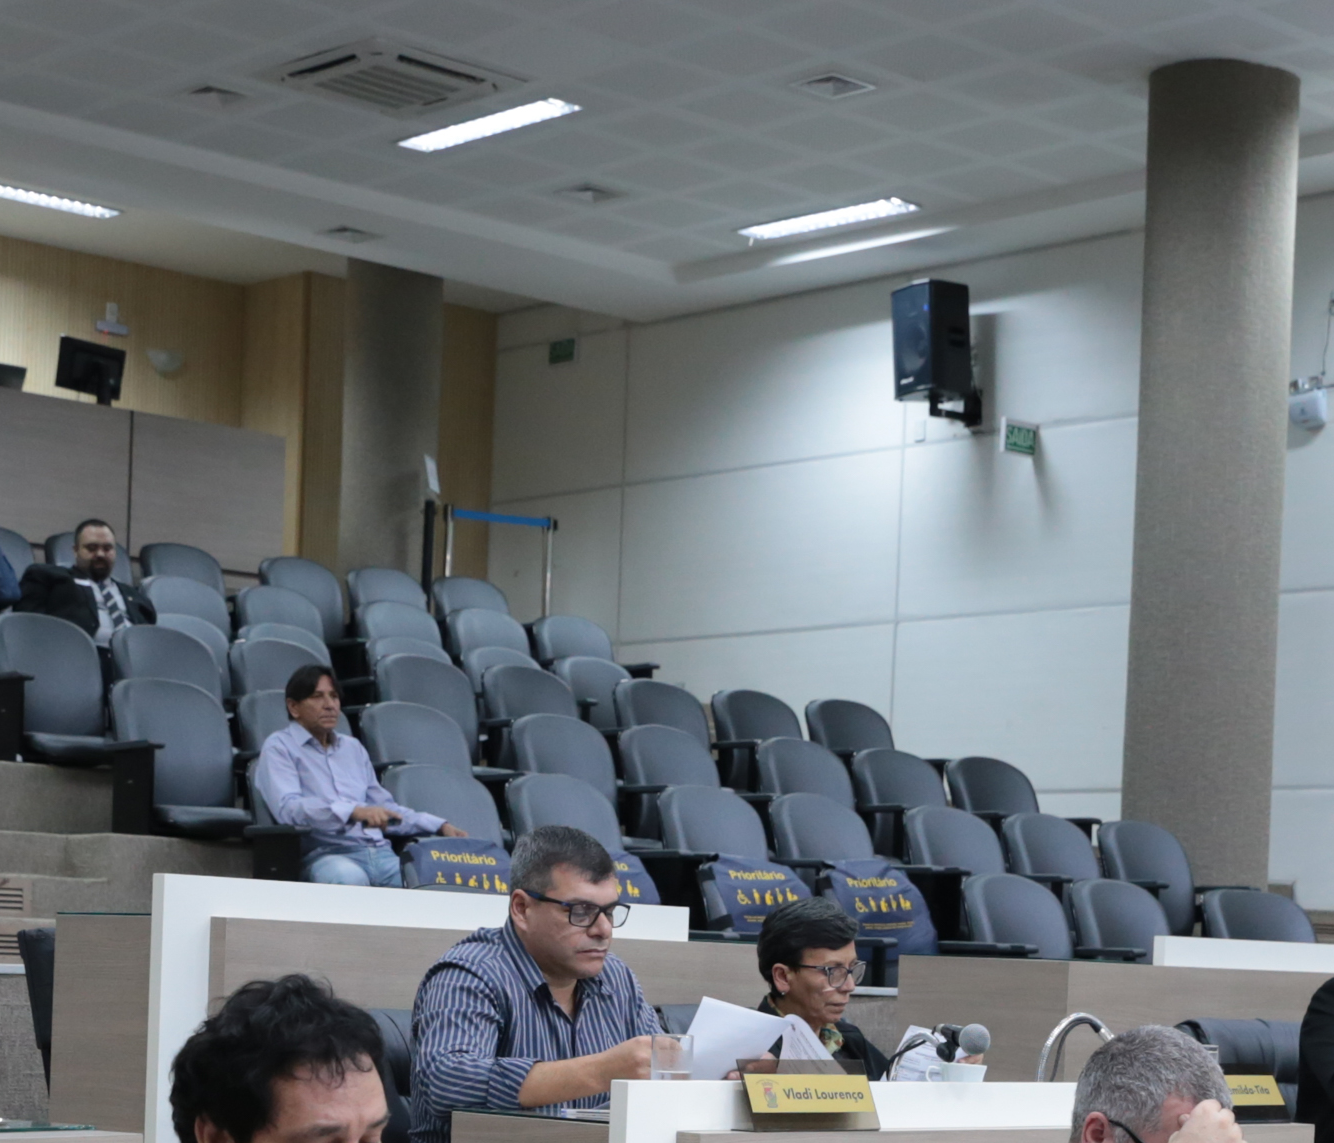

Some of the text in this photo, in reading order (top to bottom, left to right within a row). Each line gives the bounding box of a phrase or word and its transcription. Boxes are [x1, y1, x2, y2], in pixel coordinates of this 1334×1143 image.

[430, 850, 497, 866] Prioritário
[728, 869, 786, 881] Prioritário
[846, 877, 898, 888] Prioritário
[782, 1087, 864, 1103] Vladi Lourenço
